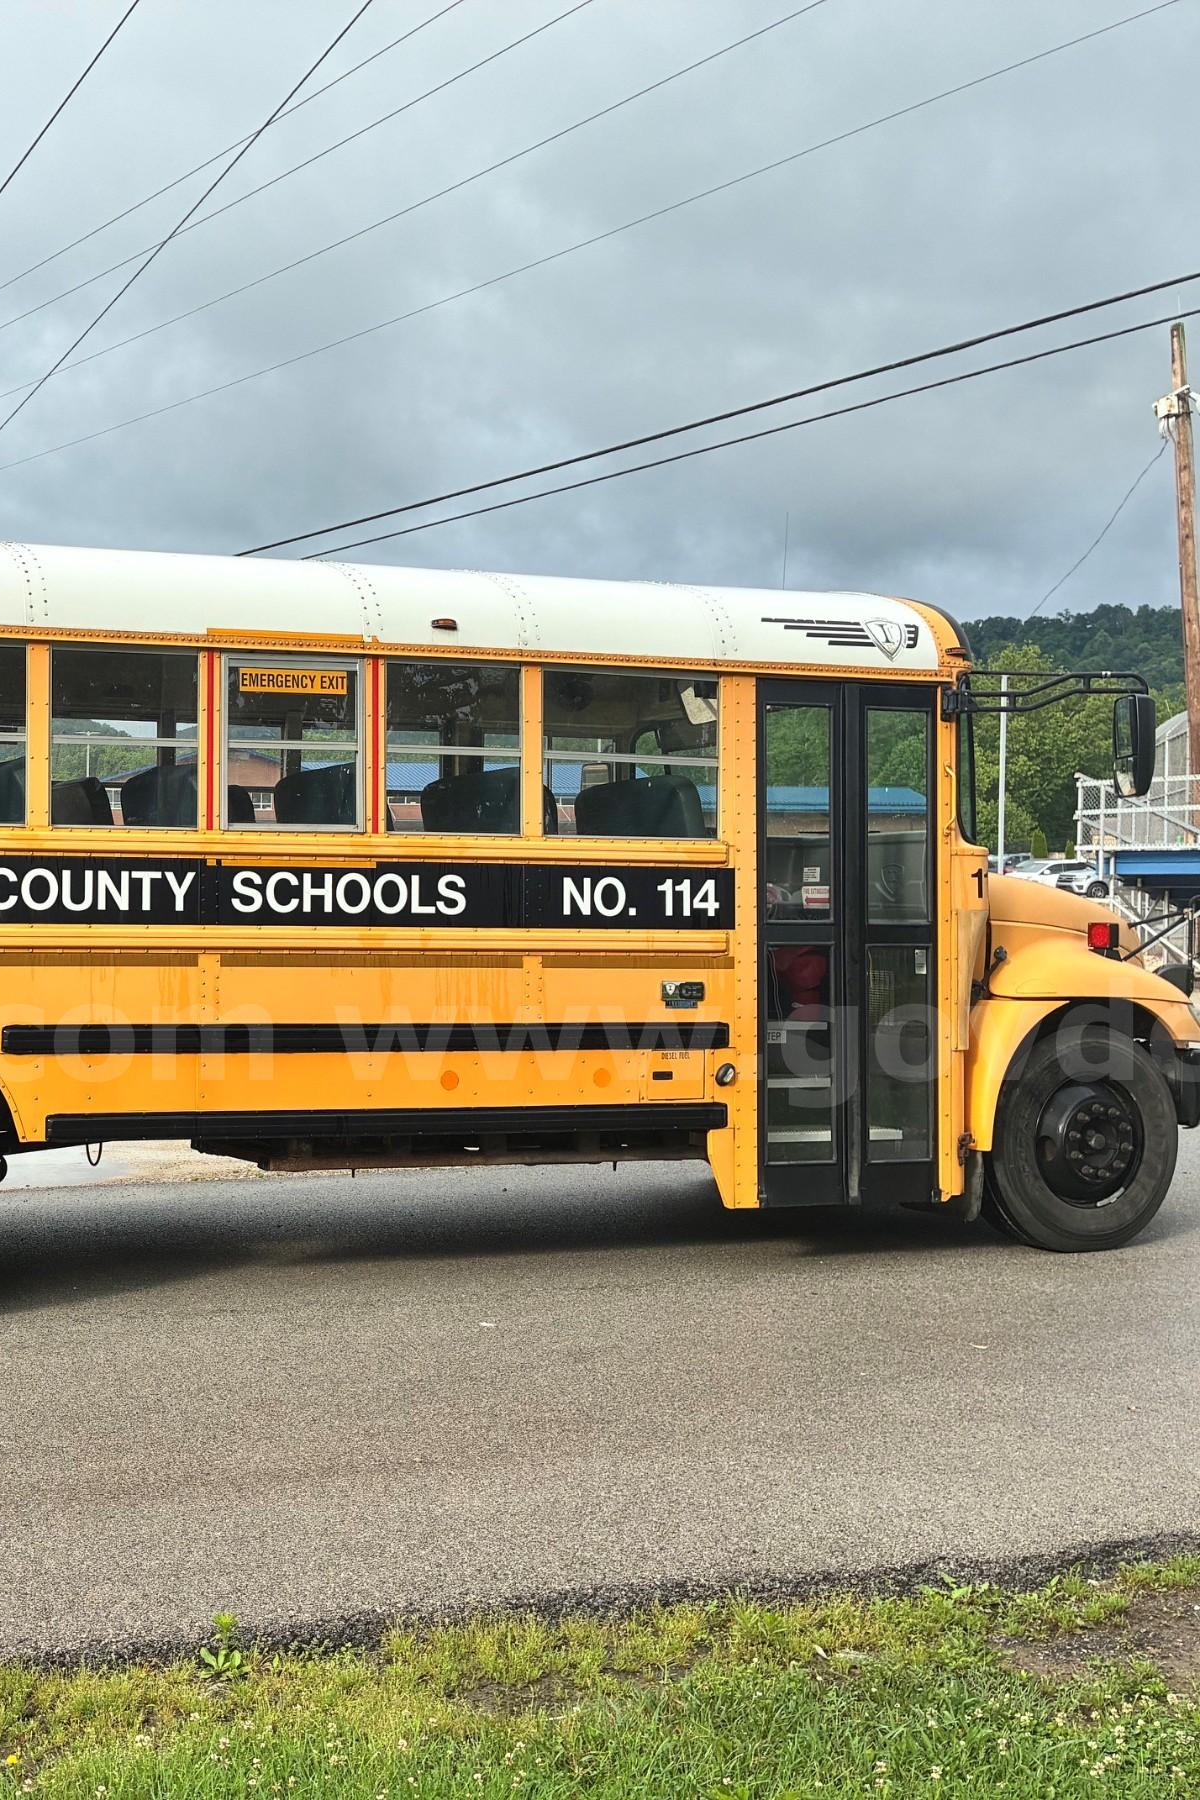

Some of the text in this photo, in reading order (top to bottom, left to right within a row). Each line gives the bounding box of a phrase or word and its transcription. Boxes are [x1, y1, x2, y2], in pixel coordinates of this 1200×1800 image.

[241, 672, 346, 690] EMERGENCY EXIT
[231, 871, 467, 915] SCHOOLS
[562, 877, 637, 917] NO.
[657, 879, 719, 917] 114
[767, 1031, 782, 1041] TEP
[661, 1051, 690, 1060] DIESEL FUEL
